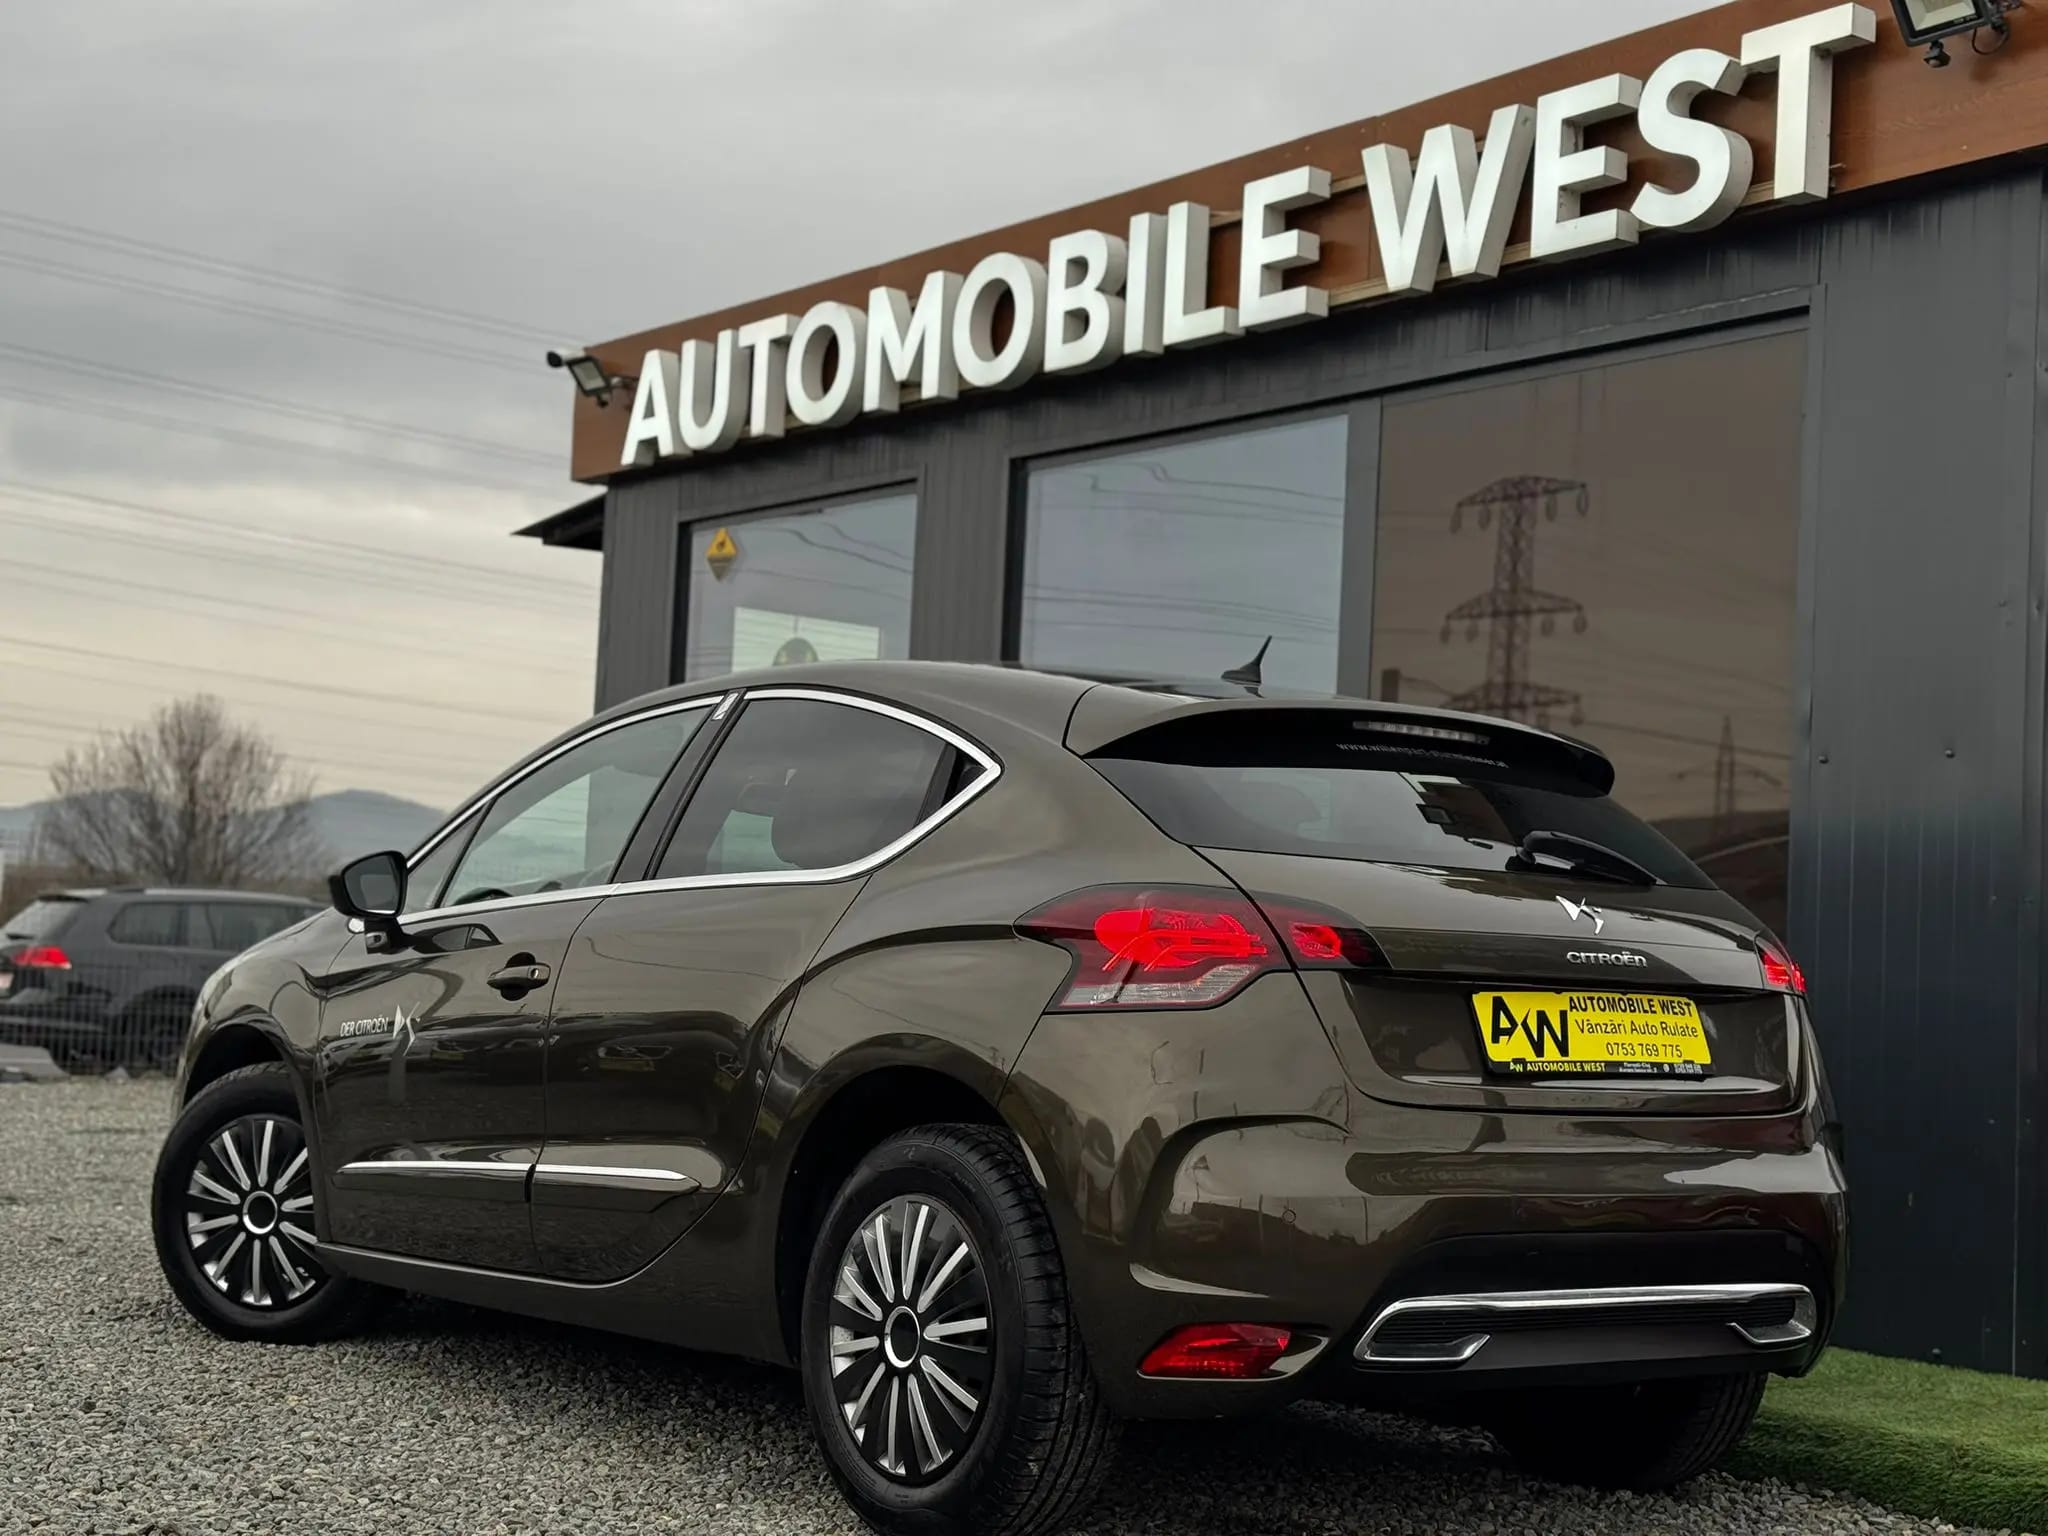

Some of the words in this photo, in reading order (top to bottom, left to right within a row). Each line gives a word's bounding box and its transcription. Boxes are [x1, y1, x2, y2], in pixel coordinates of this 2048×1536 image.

[621, 167, 1331, 467] AUTOMOBILE
[1361, 2, 1876, 294] WEST
[1569, 996, 1657, 1014] AUTOMOBILE
[1658, 1000, 1693, 1017] WEST
[340, 1022, 354, 1037] DER
[1630, 1021, 1658, 1036] Auto
[1660, 1021, 1698, 1038] Rulate
[1606, 1042, 1636, 1056] 0753
[1638, 1043, 1659, 1057] 769
[1662, 1044, 1683, 1058] 775
[1526, 1062, 1582, 1072] AUTOMOBILE
[1583, 1062, 1606, 1072] WEST
